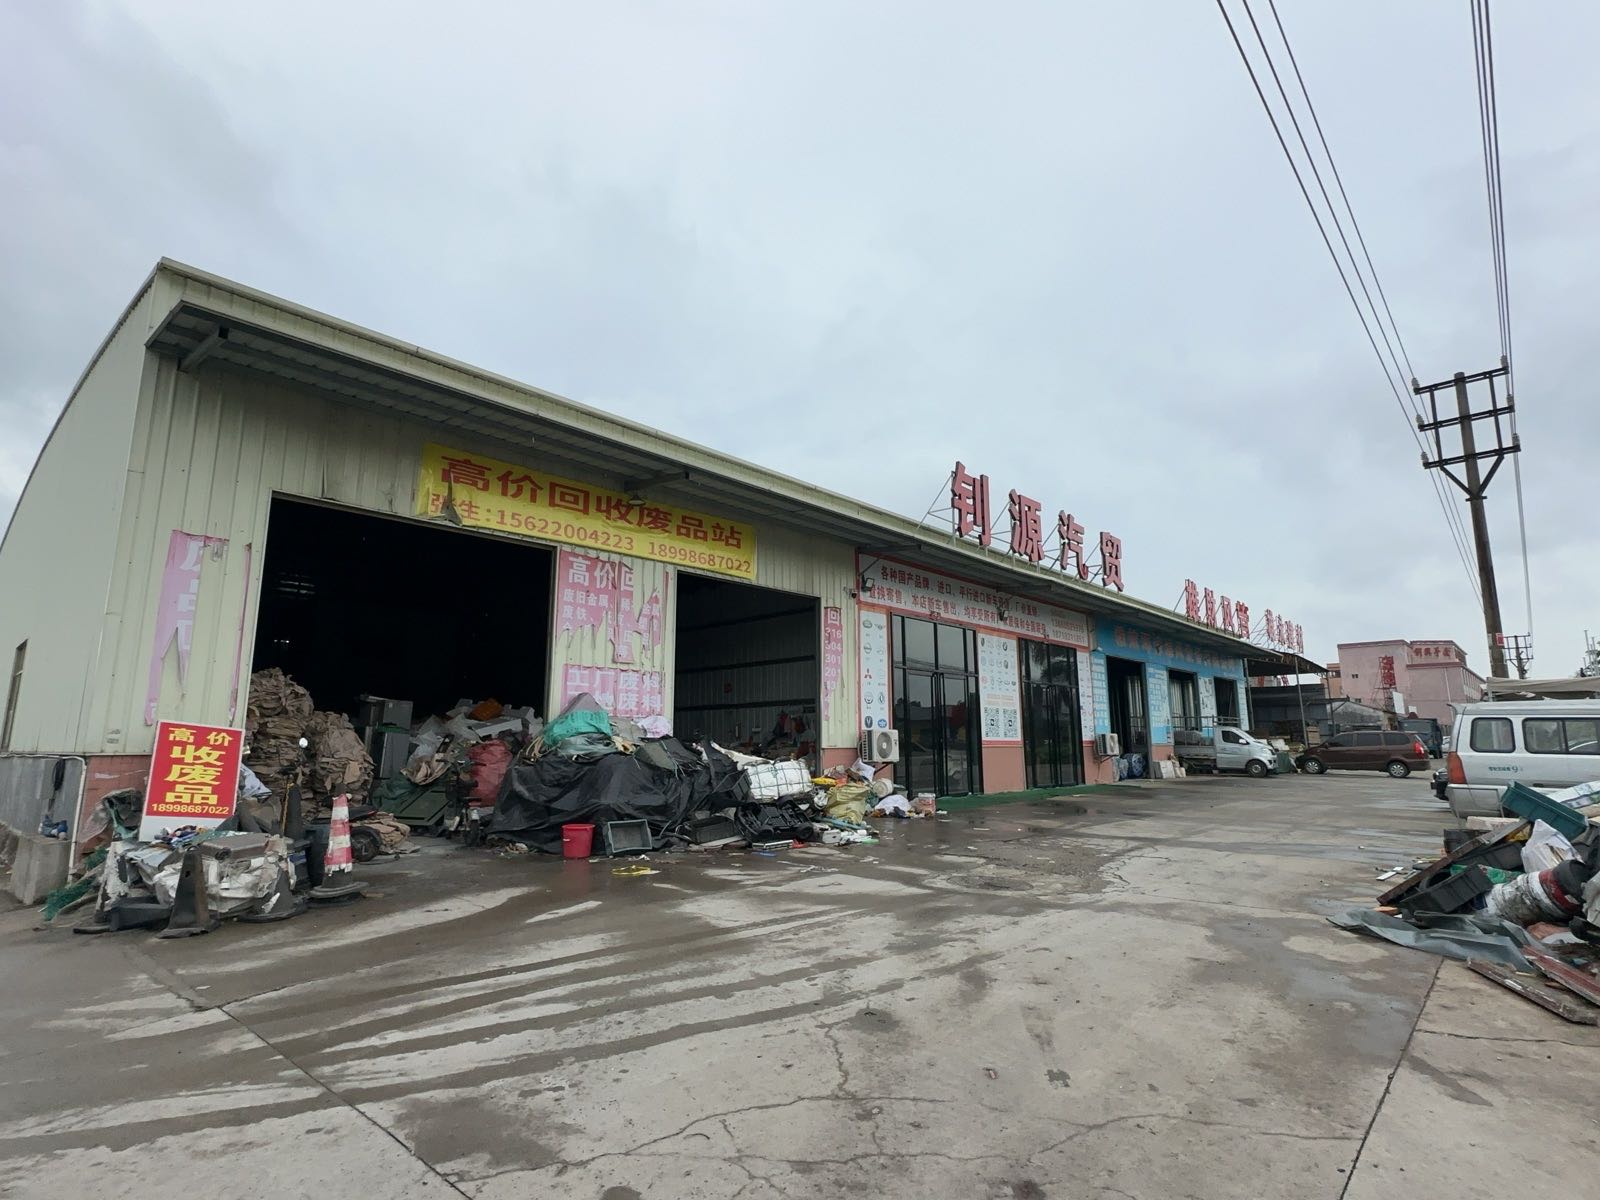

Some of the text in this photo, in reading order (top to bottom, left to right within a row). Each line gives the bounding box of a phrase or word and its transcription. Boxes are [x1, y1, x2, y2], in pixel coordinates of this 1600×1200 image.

[441, 455, 742, 549] 高价回收废品站
[951, 461, 1125, 592] 钊源汽贸
[648, 541, 752, 574] 18998687022
[151, 803, 230, 815] 18998687022
